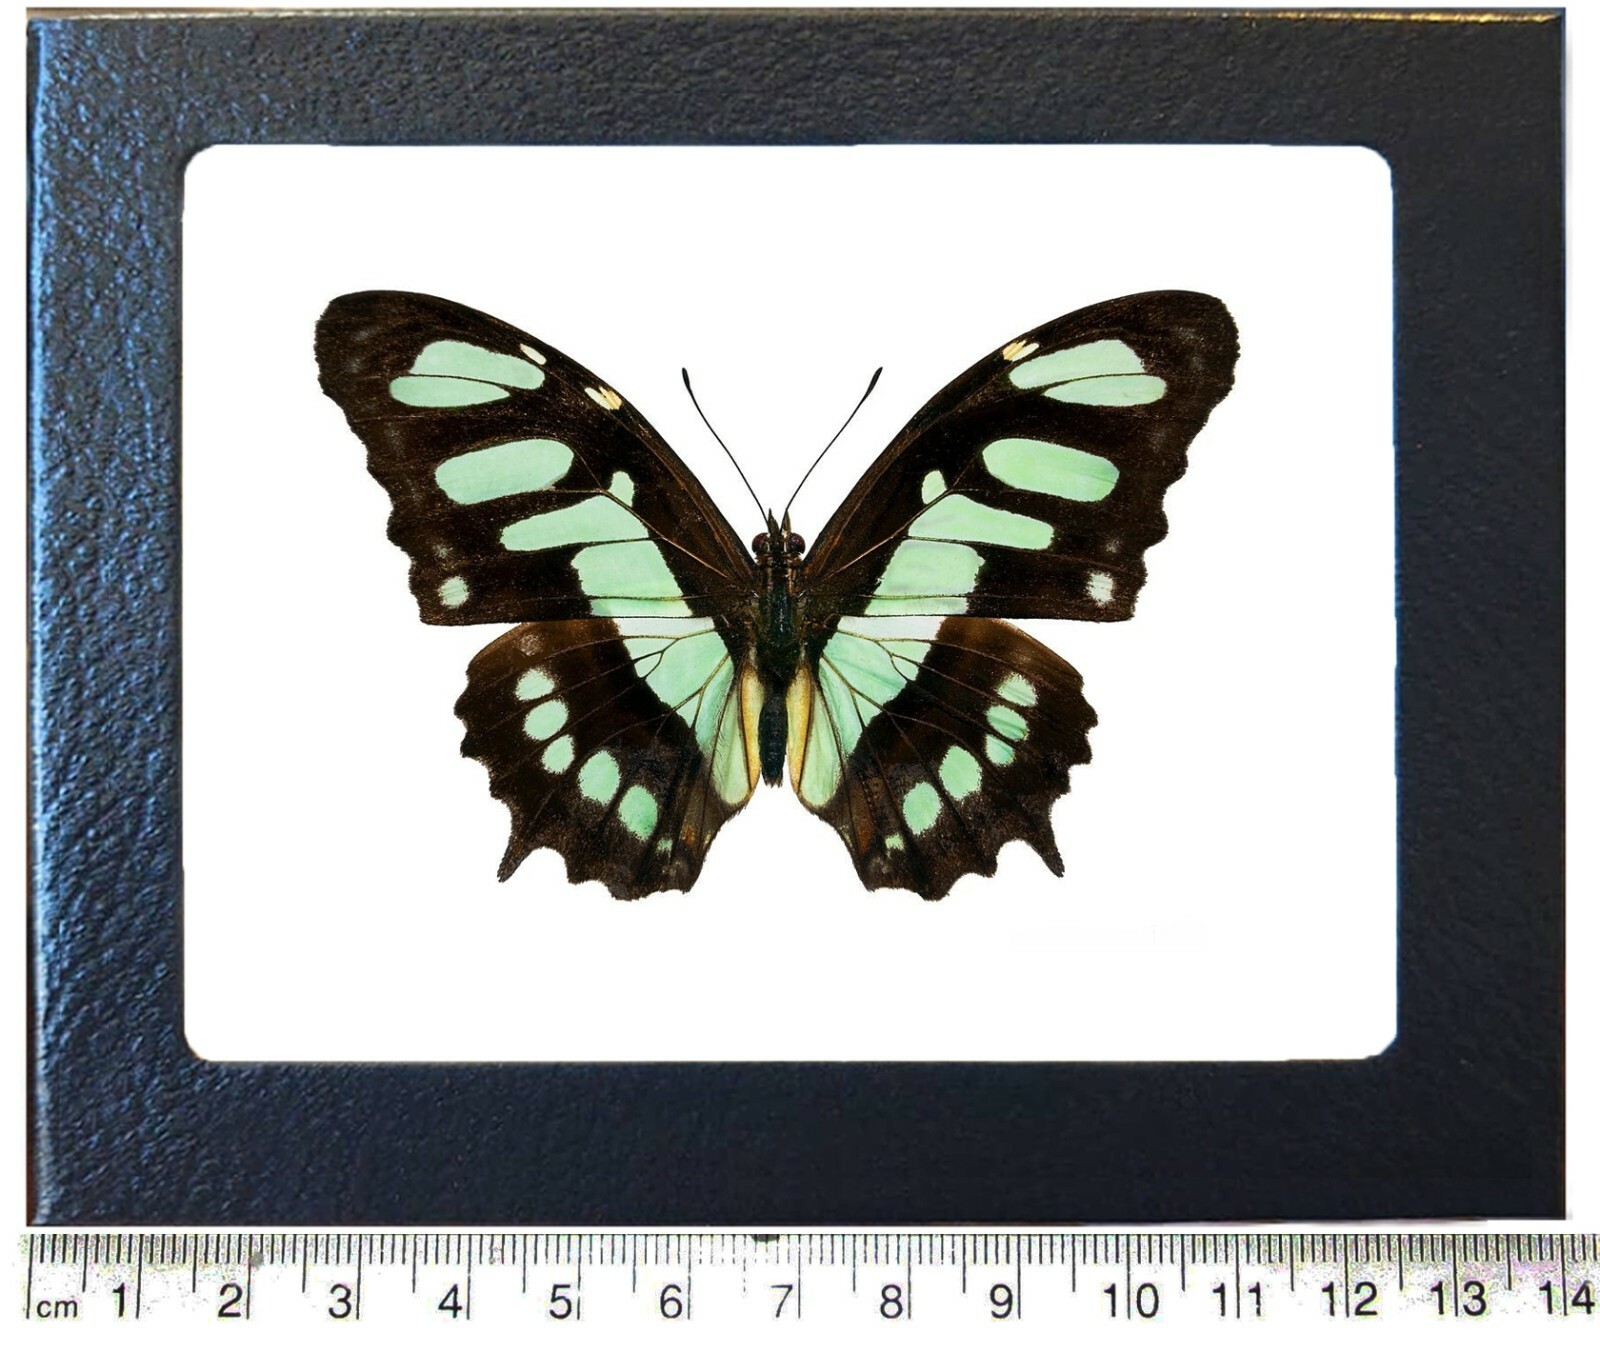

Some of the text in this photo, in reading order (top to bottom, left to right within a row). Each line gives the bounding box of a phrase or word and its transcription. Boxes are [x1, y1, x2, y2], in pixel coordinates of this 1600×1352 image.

[36, 1280, 1595, 1319] cm 1 2 3 4 5 6 7 8 9 10 11 12 13 14
